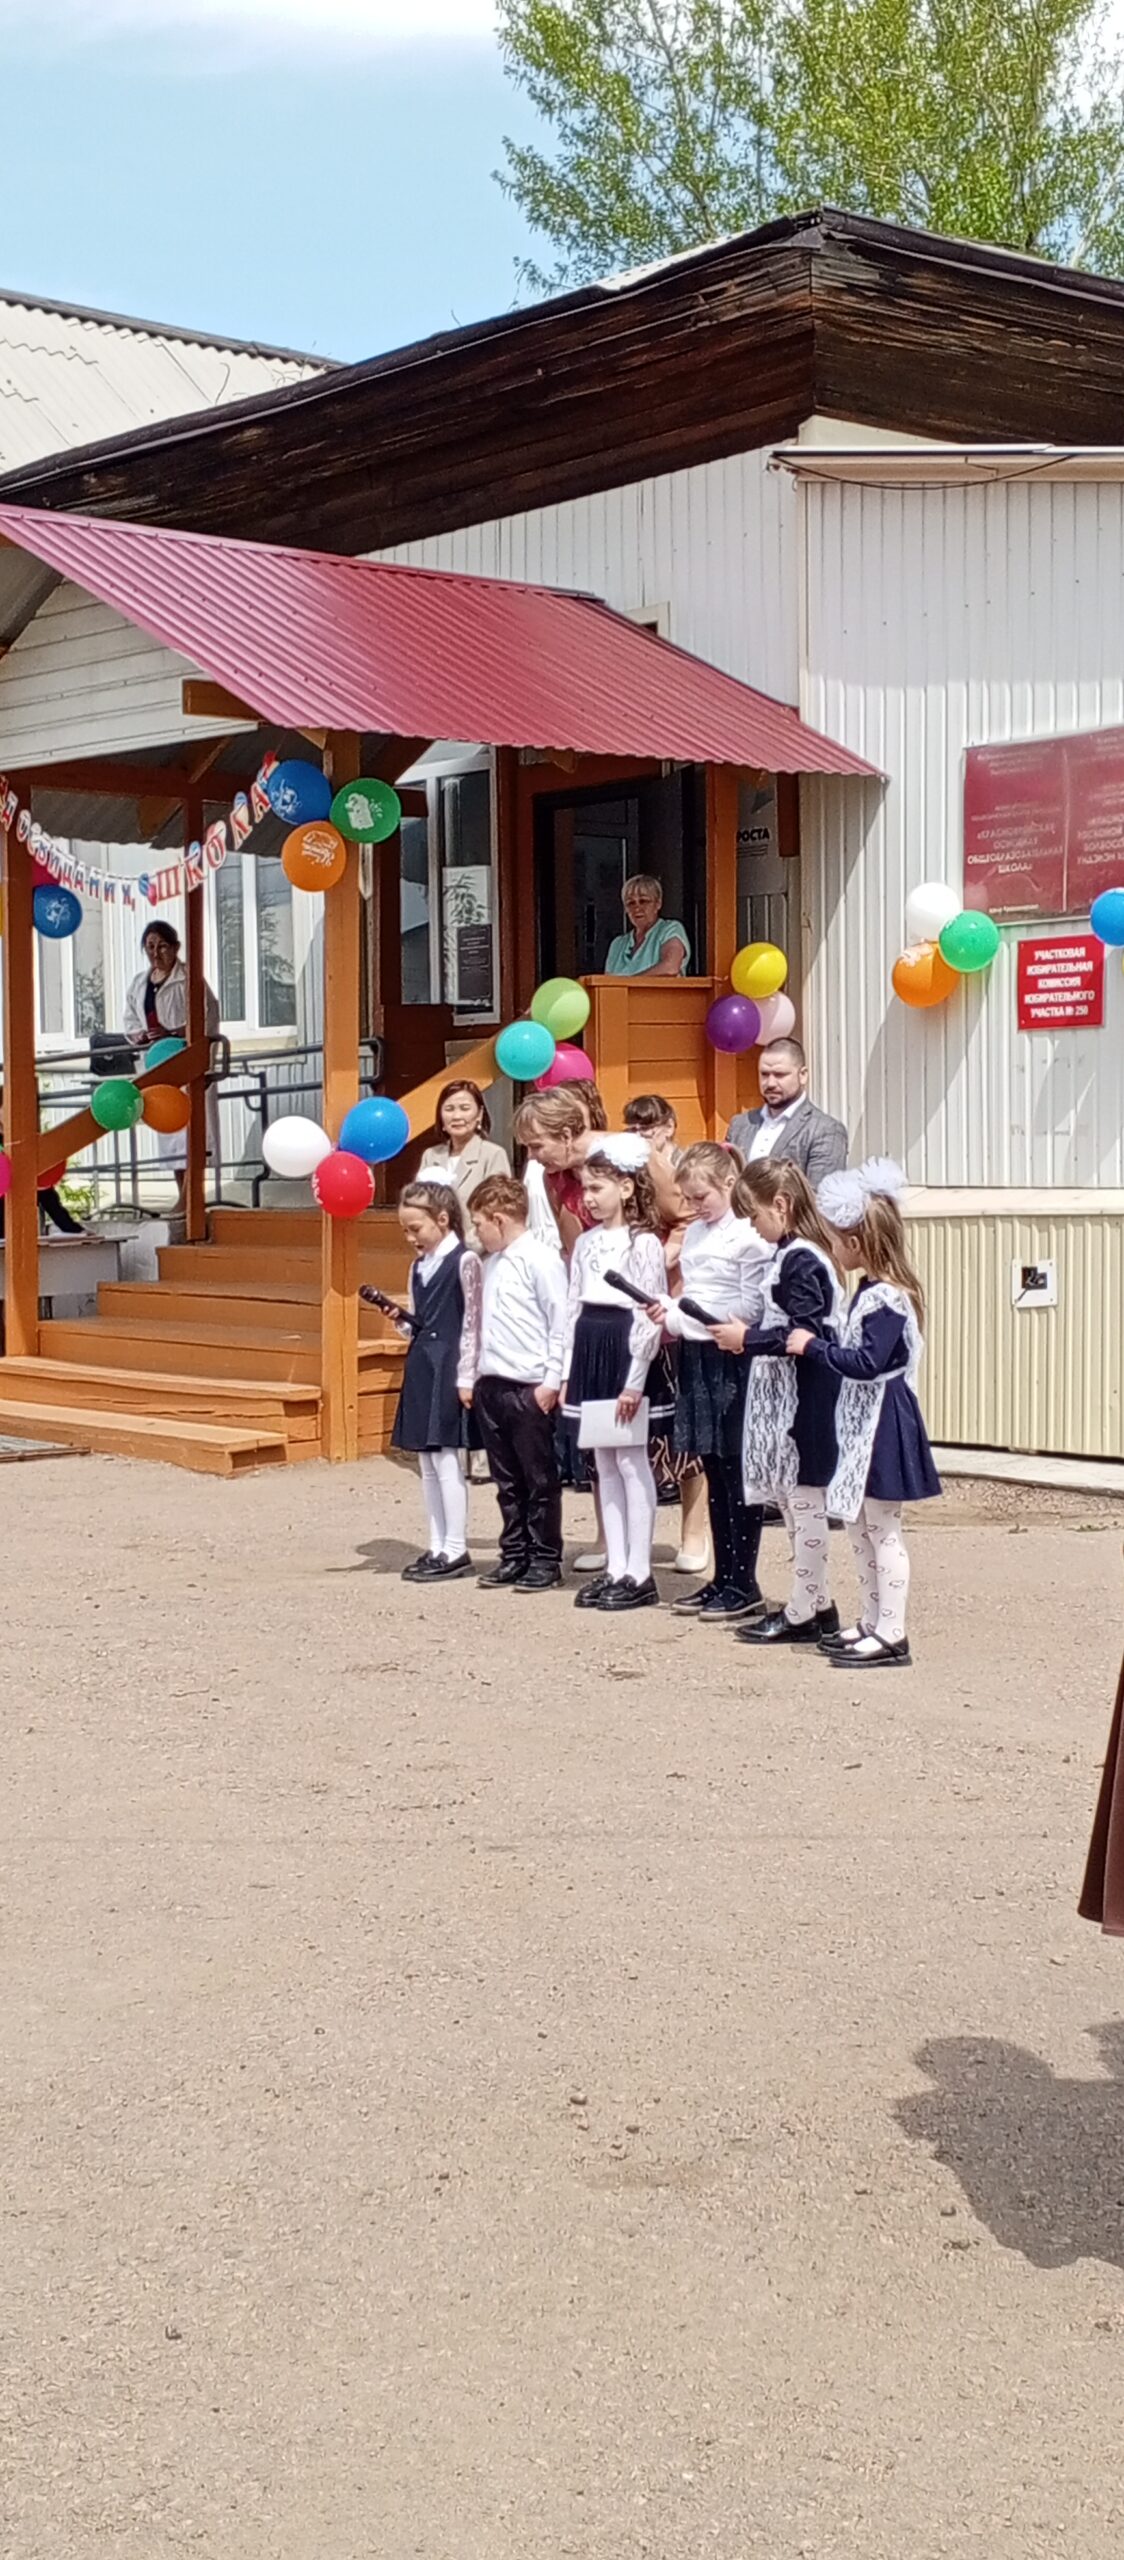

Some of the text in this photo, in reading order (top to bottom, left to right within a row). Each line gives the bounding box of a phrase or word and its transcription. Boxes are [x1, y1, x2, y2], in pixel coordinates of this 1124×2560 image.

[1034, 947, 1086, 960] УЧАСТКОВАЯ
[1027, 961, 1093, 976] ИЗБИРАТЕЛЬНАЯ
[1038, 976, 1081, 989] КОМИССИЯ
[1024, 990, 1095, 1005] ИЗБИРАТЕЛЬНОГО
[1030, 1006, 1064, 1019] УЧАСТКА
[1075, 1005, 1088, 1016] 250
